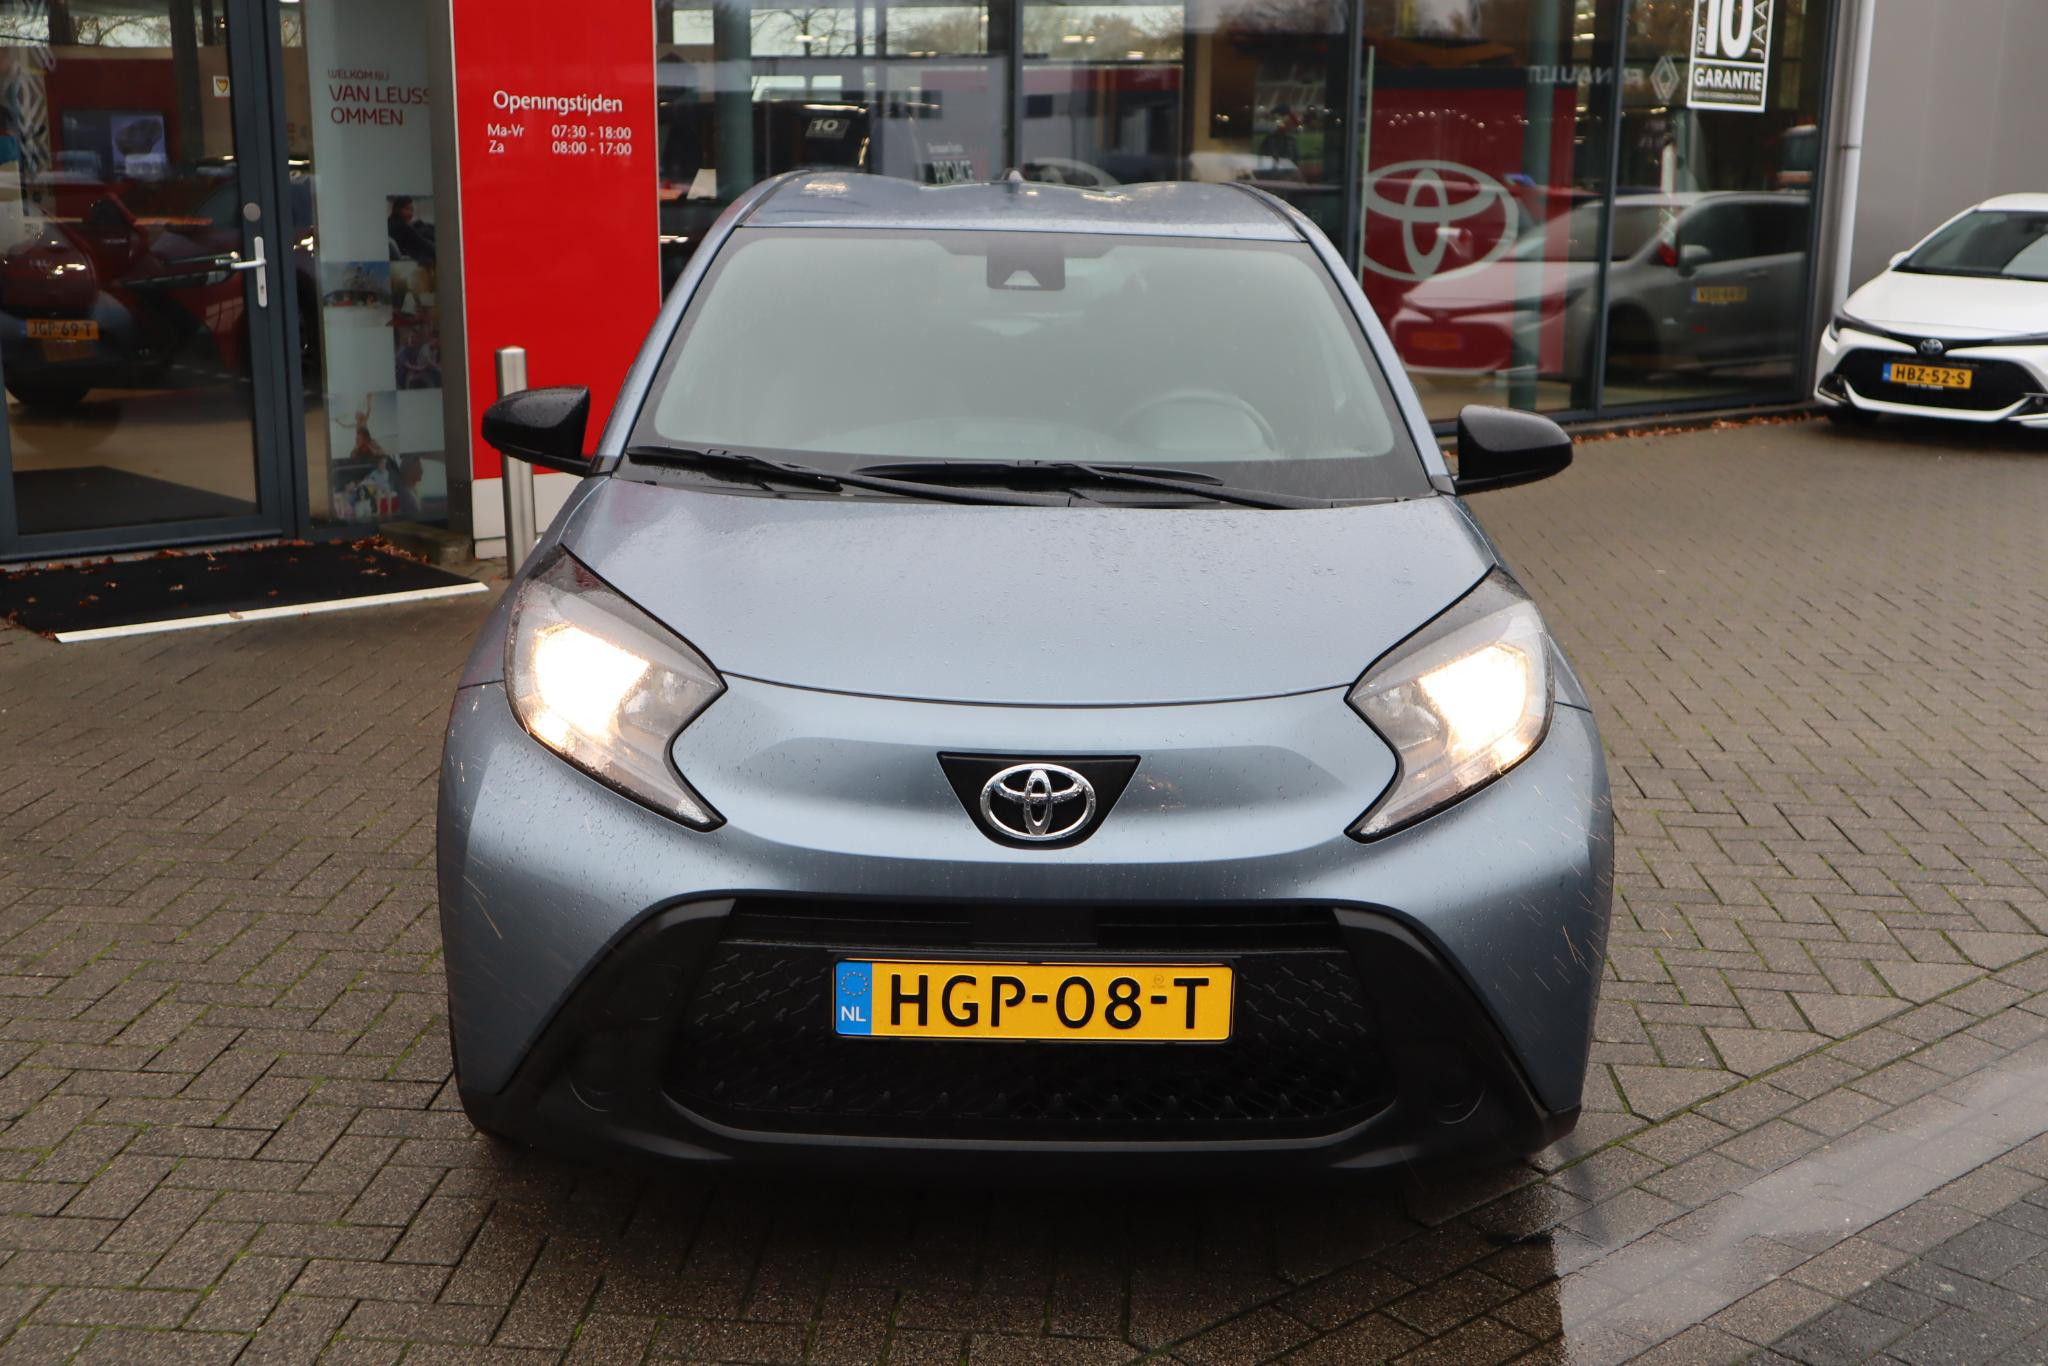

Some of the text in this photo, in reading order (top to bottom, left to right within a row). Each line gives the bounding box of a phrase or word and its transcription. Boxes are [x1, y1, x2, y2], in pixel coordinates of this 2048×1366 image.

[1699, 0, 1755, 59] 10
[327, 67, 373, 81] WELKOM
[1693, 67, 1763, 92] GARANTIE
[328, 83, 371, 103] VAN
[493, 90, 623, 116] Openingstijden
[330, 106, 404, 126] OMMEN
[487, 123, 525, 138] Ma-Vr
[551, 124, 587, 139] 07:30
[598, 125, 632, 140] 18:00
[488, 139, 505, 154] Za
[551, 140, 587, 155] 08:00
[598, 142, 632, 156] 17:00
[1895, 365, 1966, 386] HBZ-52-S
[841, 973, 1211, 1030] NL HGP-08-T
